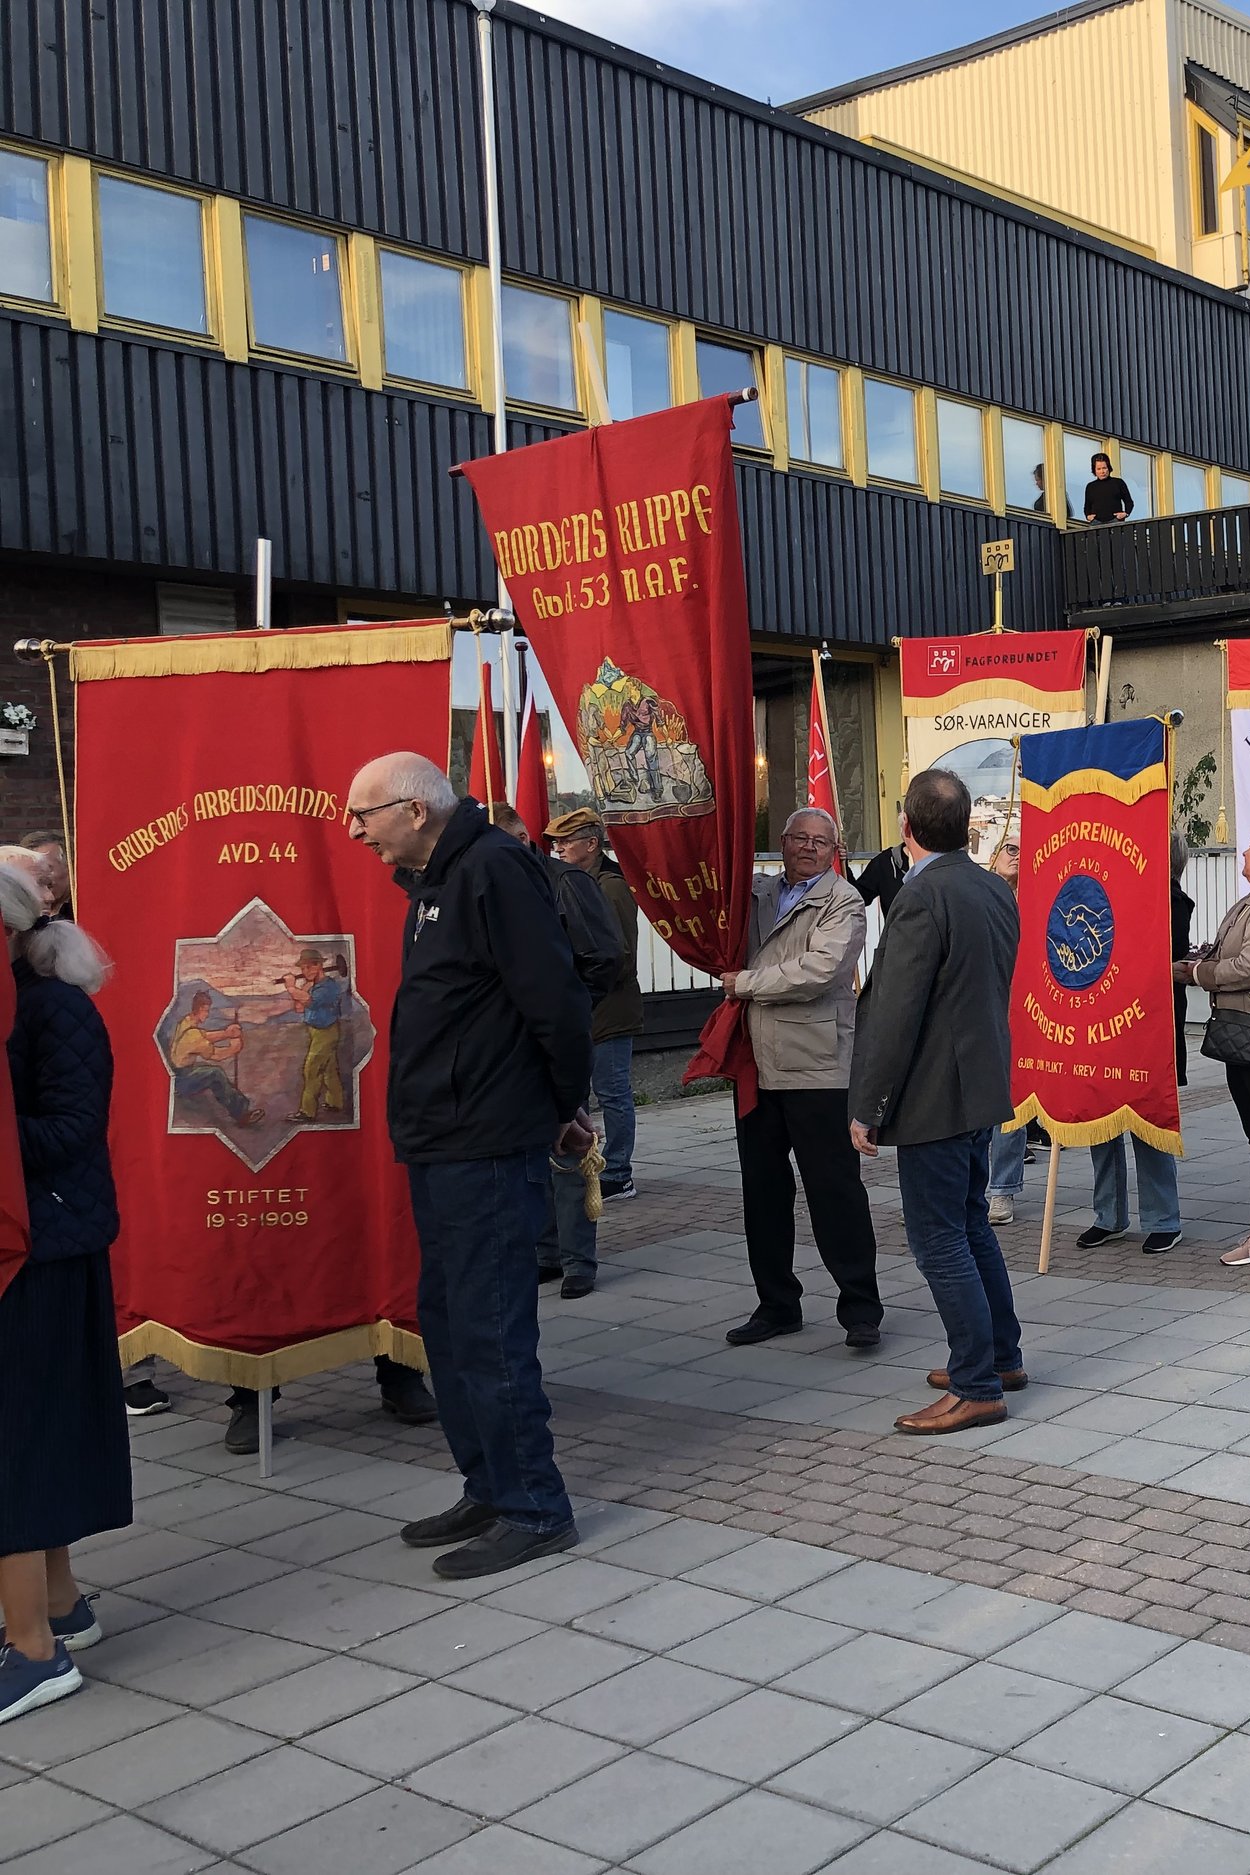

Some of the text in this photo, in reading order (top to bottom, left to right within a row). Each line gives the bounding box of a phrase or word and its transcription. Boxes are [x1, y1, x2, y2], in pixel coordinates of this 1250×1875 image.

[494, 484, 713, 579] NORDENS KLIPPE
[965, 650, 1059, 667] FAGFORBUNDET
[934, 712, 1052, 731] SØR-VARANGER
[108, 802, 189, 872] GRUBERNES
[1032, 821, 1147, 875] GRUBEFORENINGEN
[217, 842, 298, 864] AVD. 44
[1069, 963, 1120, 1008] 13-5-1973
[1023, 992, 1146, 1046] NORDENS KLIPPE
[1017, 1057, 1034, 1069] GJØR
[1073, 1064, 1097, 1077] KREV
[1103, 1066, 1122, 1080] DIN
[1129, 1069, 1149, 1083] RETT
[207, 1188, 309, 1205] STIFTET
[206, 1211, 309, 1228] 19-3-1909
